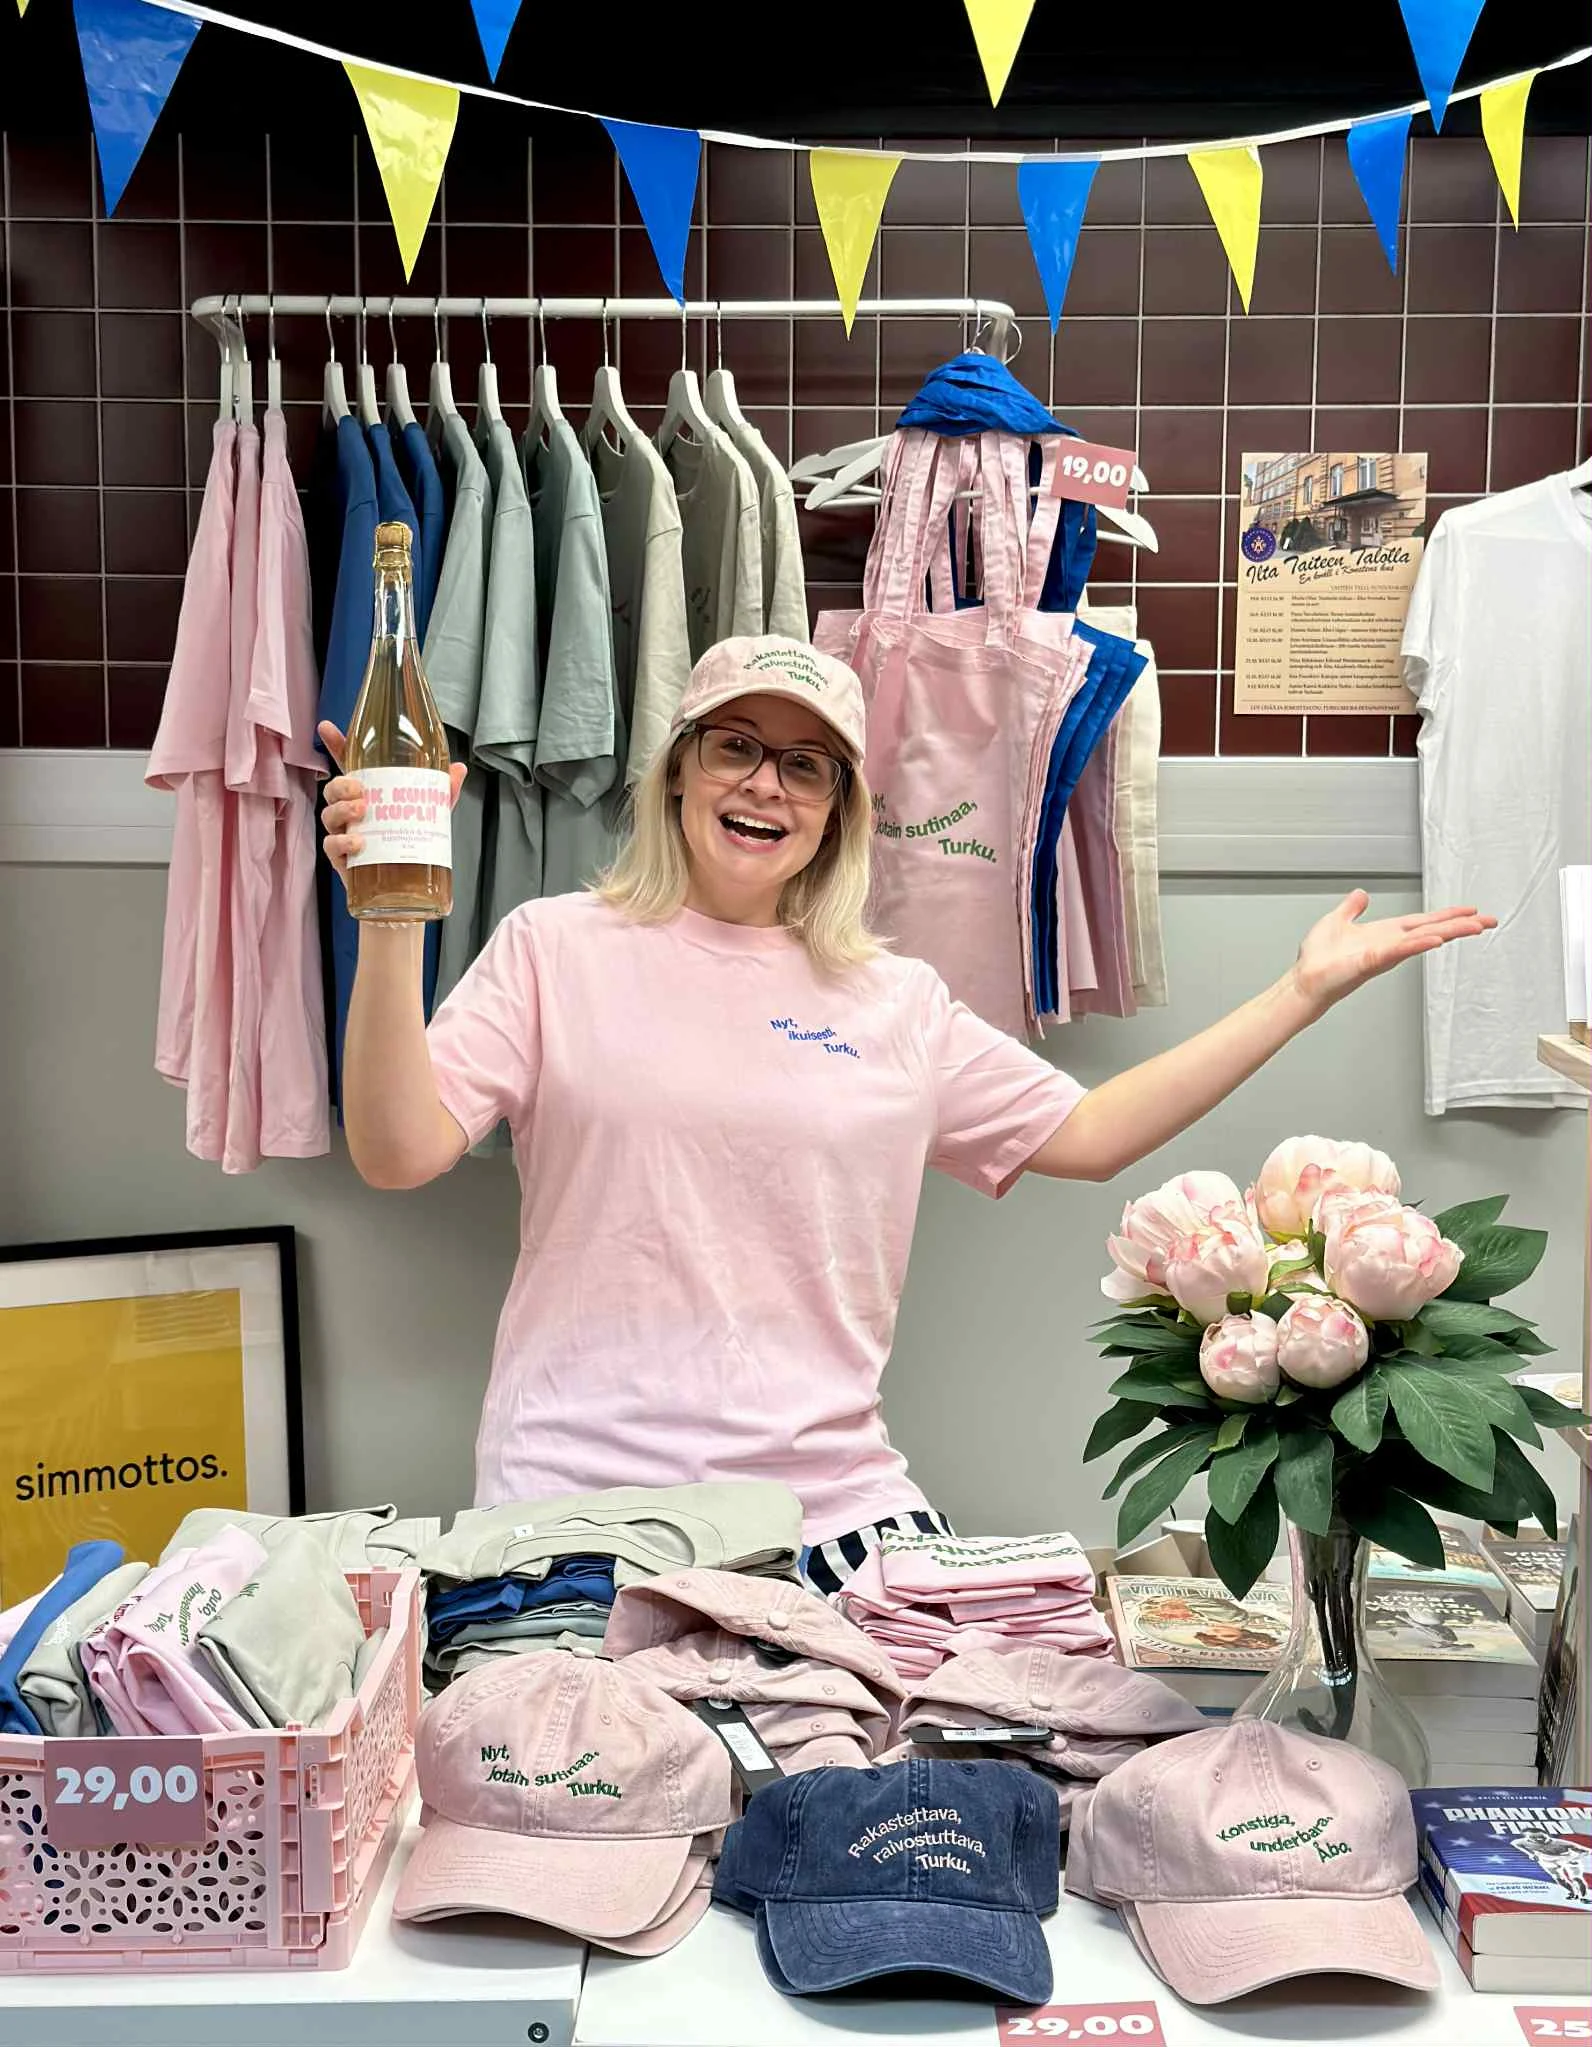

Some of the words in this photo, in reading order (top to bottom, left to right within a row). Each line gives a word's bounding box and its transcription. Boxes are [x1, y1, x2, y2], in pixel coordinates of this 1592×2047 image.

[1062, 455, 1128, 488] 19,00
[1283, 551, 1345, 576] Taiteen
[905, 799, 979, 839] sutinaa,
[938, 838, 998, 864] Turku.
[769, 1017, 799, 1030] Nyt,
[823, 1042, 861, 1060] Turku.
[15, 1453, 228, 1501] simmottos.
[480, 1745, 511, 1763] Nyt,
[55, 1764, 199, 1811] 29,00
[486, 1765, 530, 1787] jotain
[566, 1779, 623, 1799] Turku.
[848, 1807, 962, 1859] Rakastettava,
[1216, 1814, 1296, 1842] Konstiga,
[1250, 1816, 1334, 1853] underbara,
[1489, 1821, 1575, 1835] FINN
[872, 1829, 987, 1865] raivostuttava,
[1313, 1841, 1353, 1864] Åbo.
[915, 1852, 972, 1875] Turku.
[1007, 2014, 1155, 2040] 29,00
